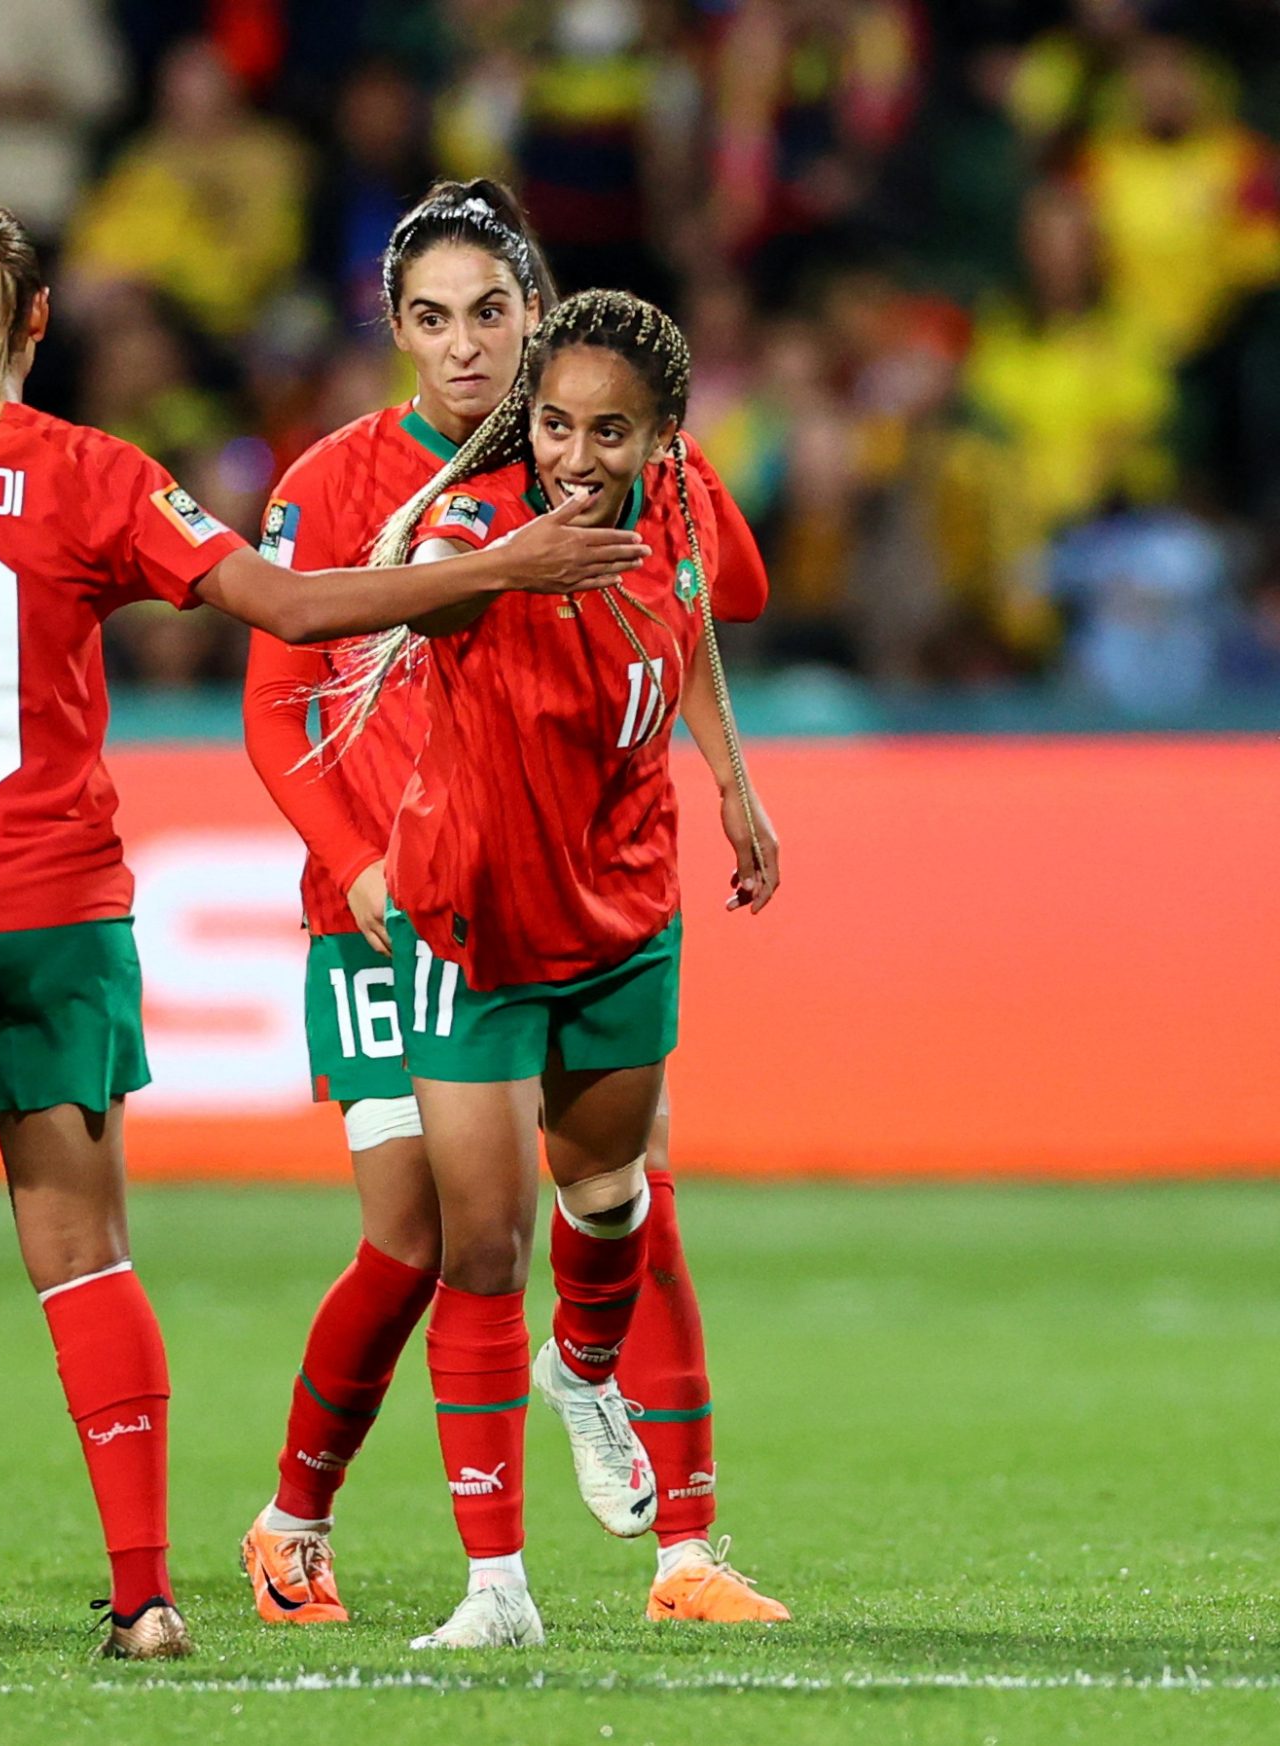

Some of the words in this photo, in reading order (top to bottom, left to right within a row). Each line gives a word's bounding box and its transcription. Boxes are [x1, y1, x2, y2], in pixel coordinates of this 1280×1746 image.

[616, 657, 664, 748] 11
[329, 967, 404, 1059] 16
[413, 939, 459, 1037] 11
[87, 1414, 152, 1446] المغرب
[448, 1481, 494, 1496] PUMA
